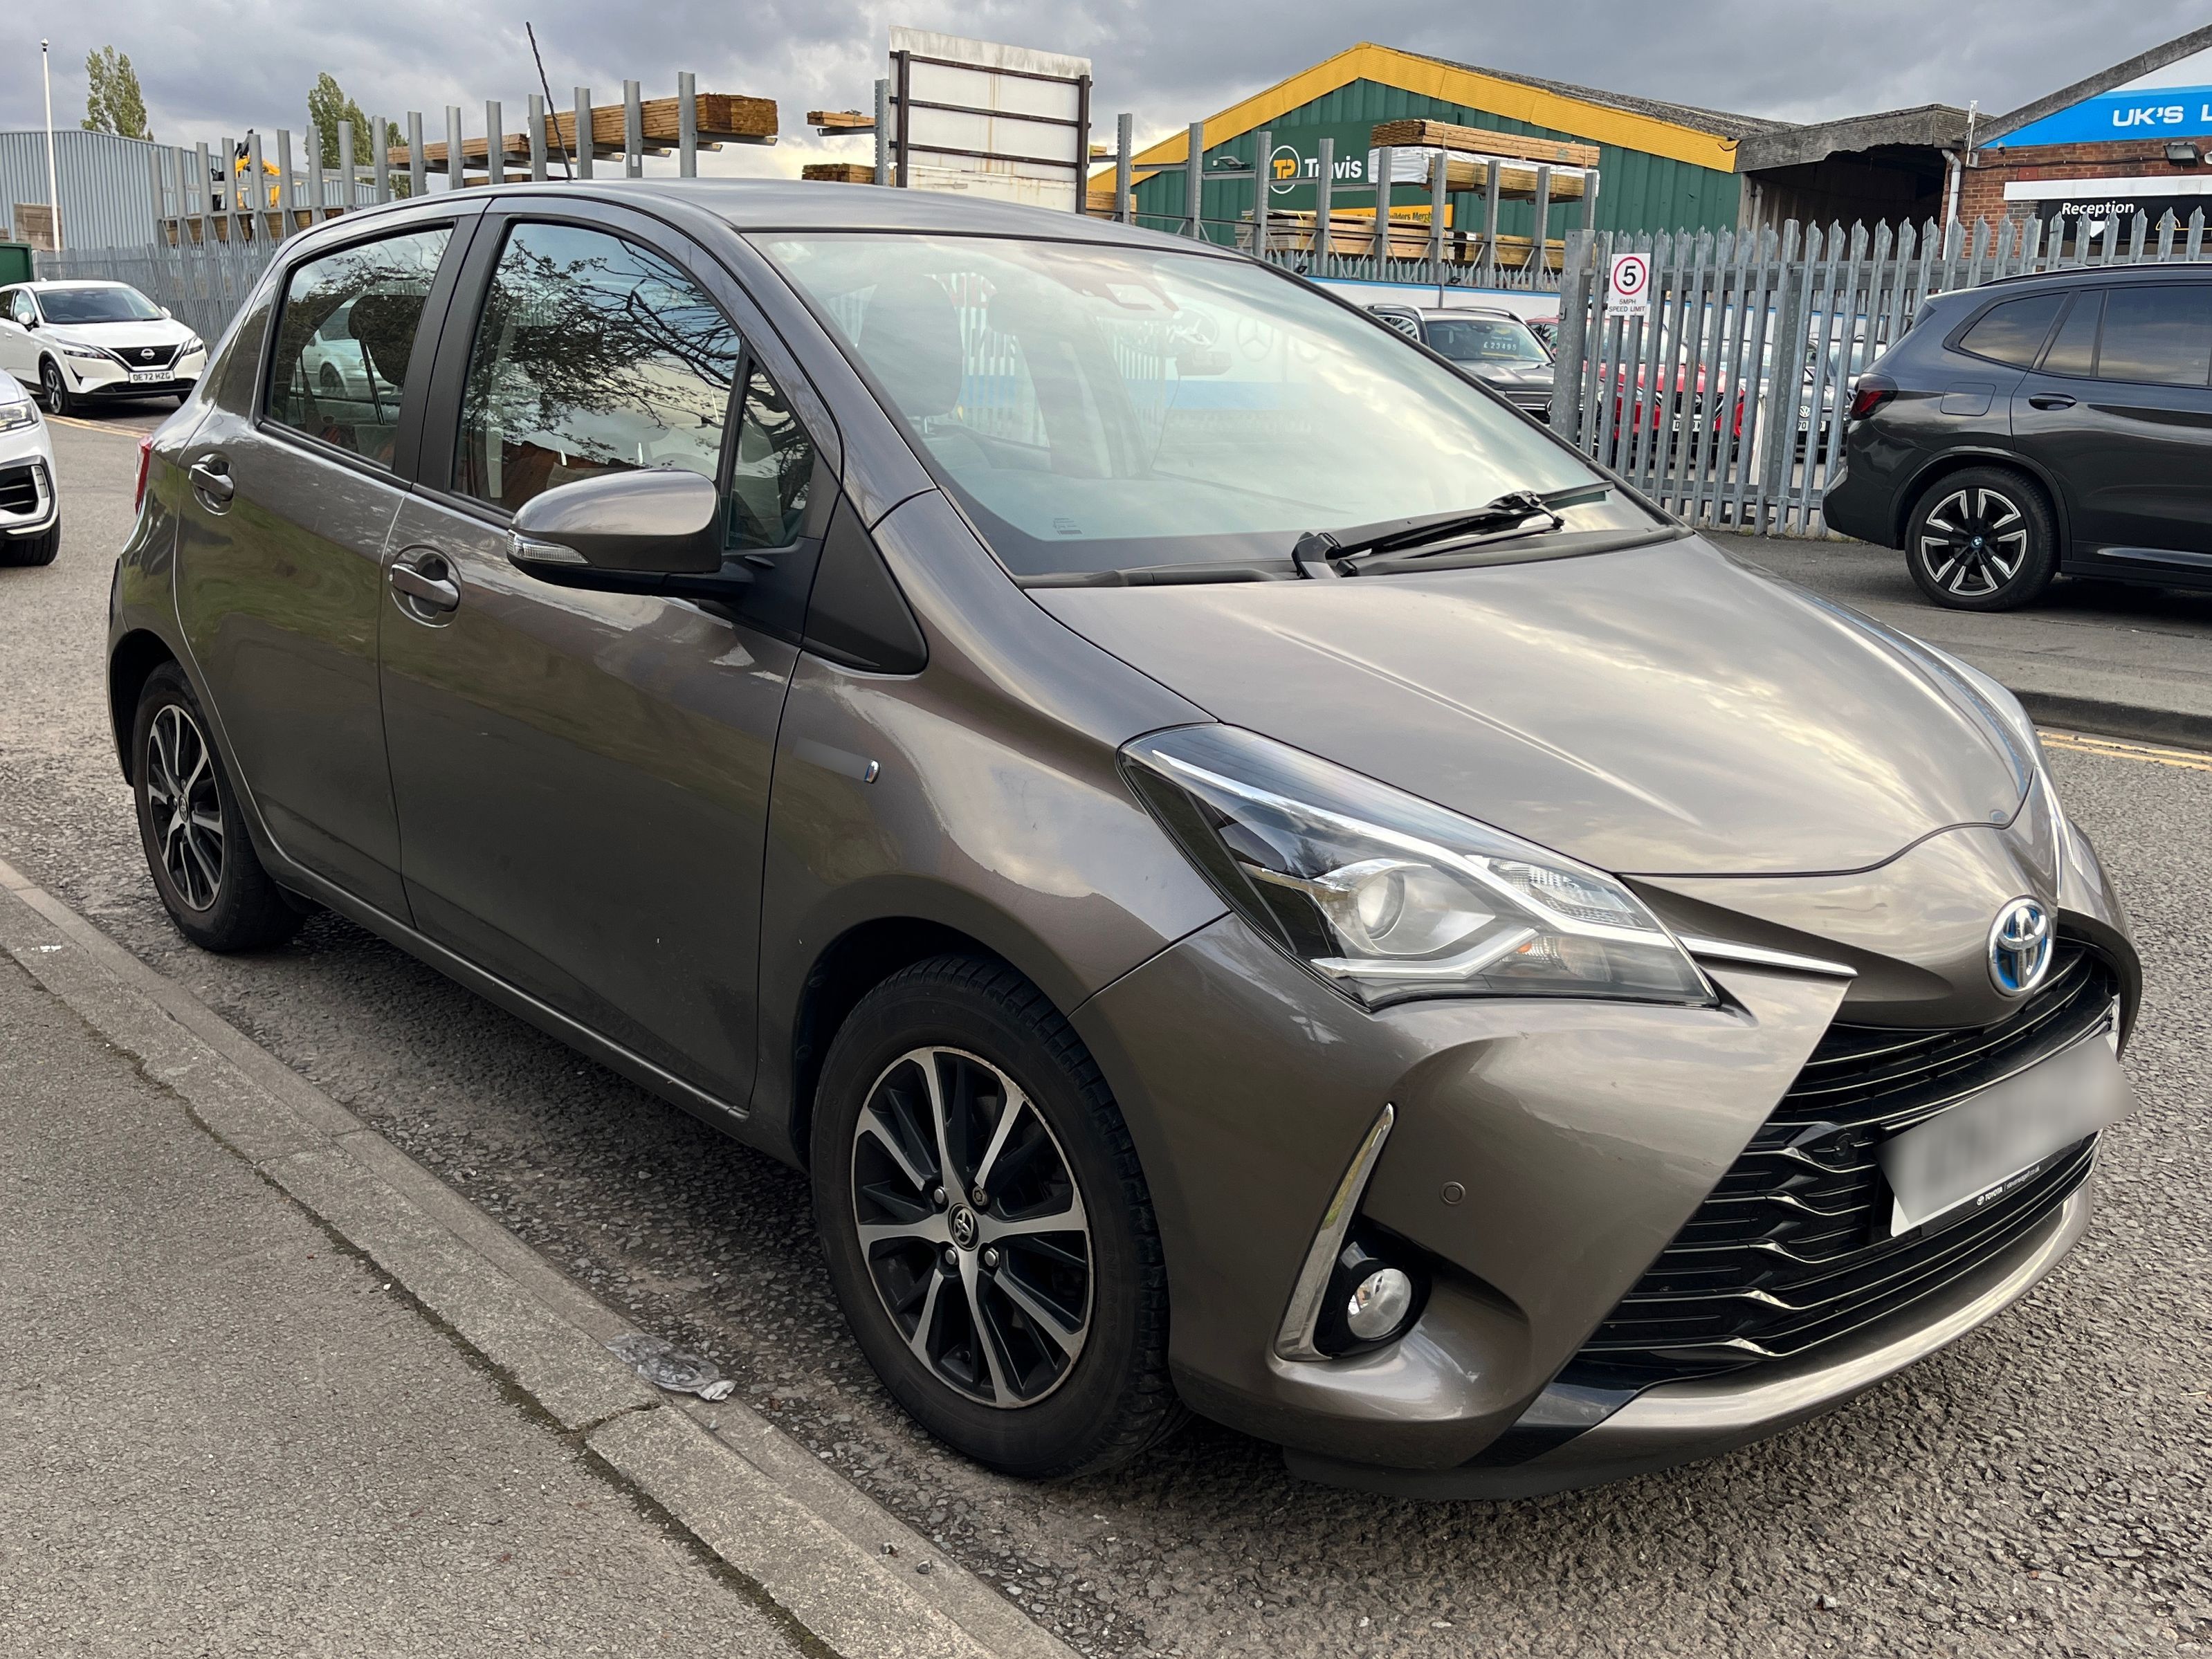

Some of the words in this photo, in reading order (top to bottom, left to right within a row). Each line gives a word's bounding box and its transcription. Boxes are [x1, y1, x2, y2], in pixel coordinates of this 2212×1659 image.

[2112, 106, 2184, 127] UK'S
[1304, 155, 1362, 179] Tvis
[2062, 200, 2134, 217] Reception
[1622, 265, 1636, 287] 5
[1984, 1186, 2003, 1201] TOYOTA
